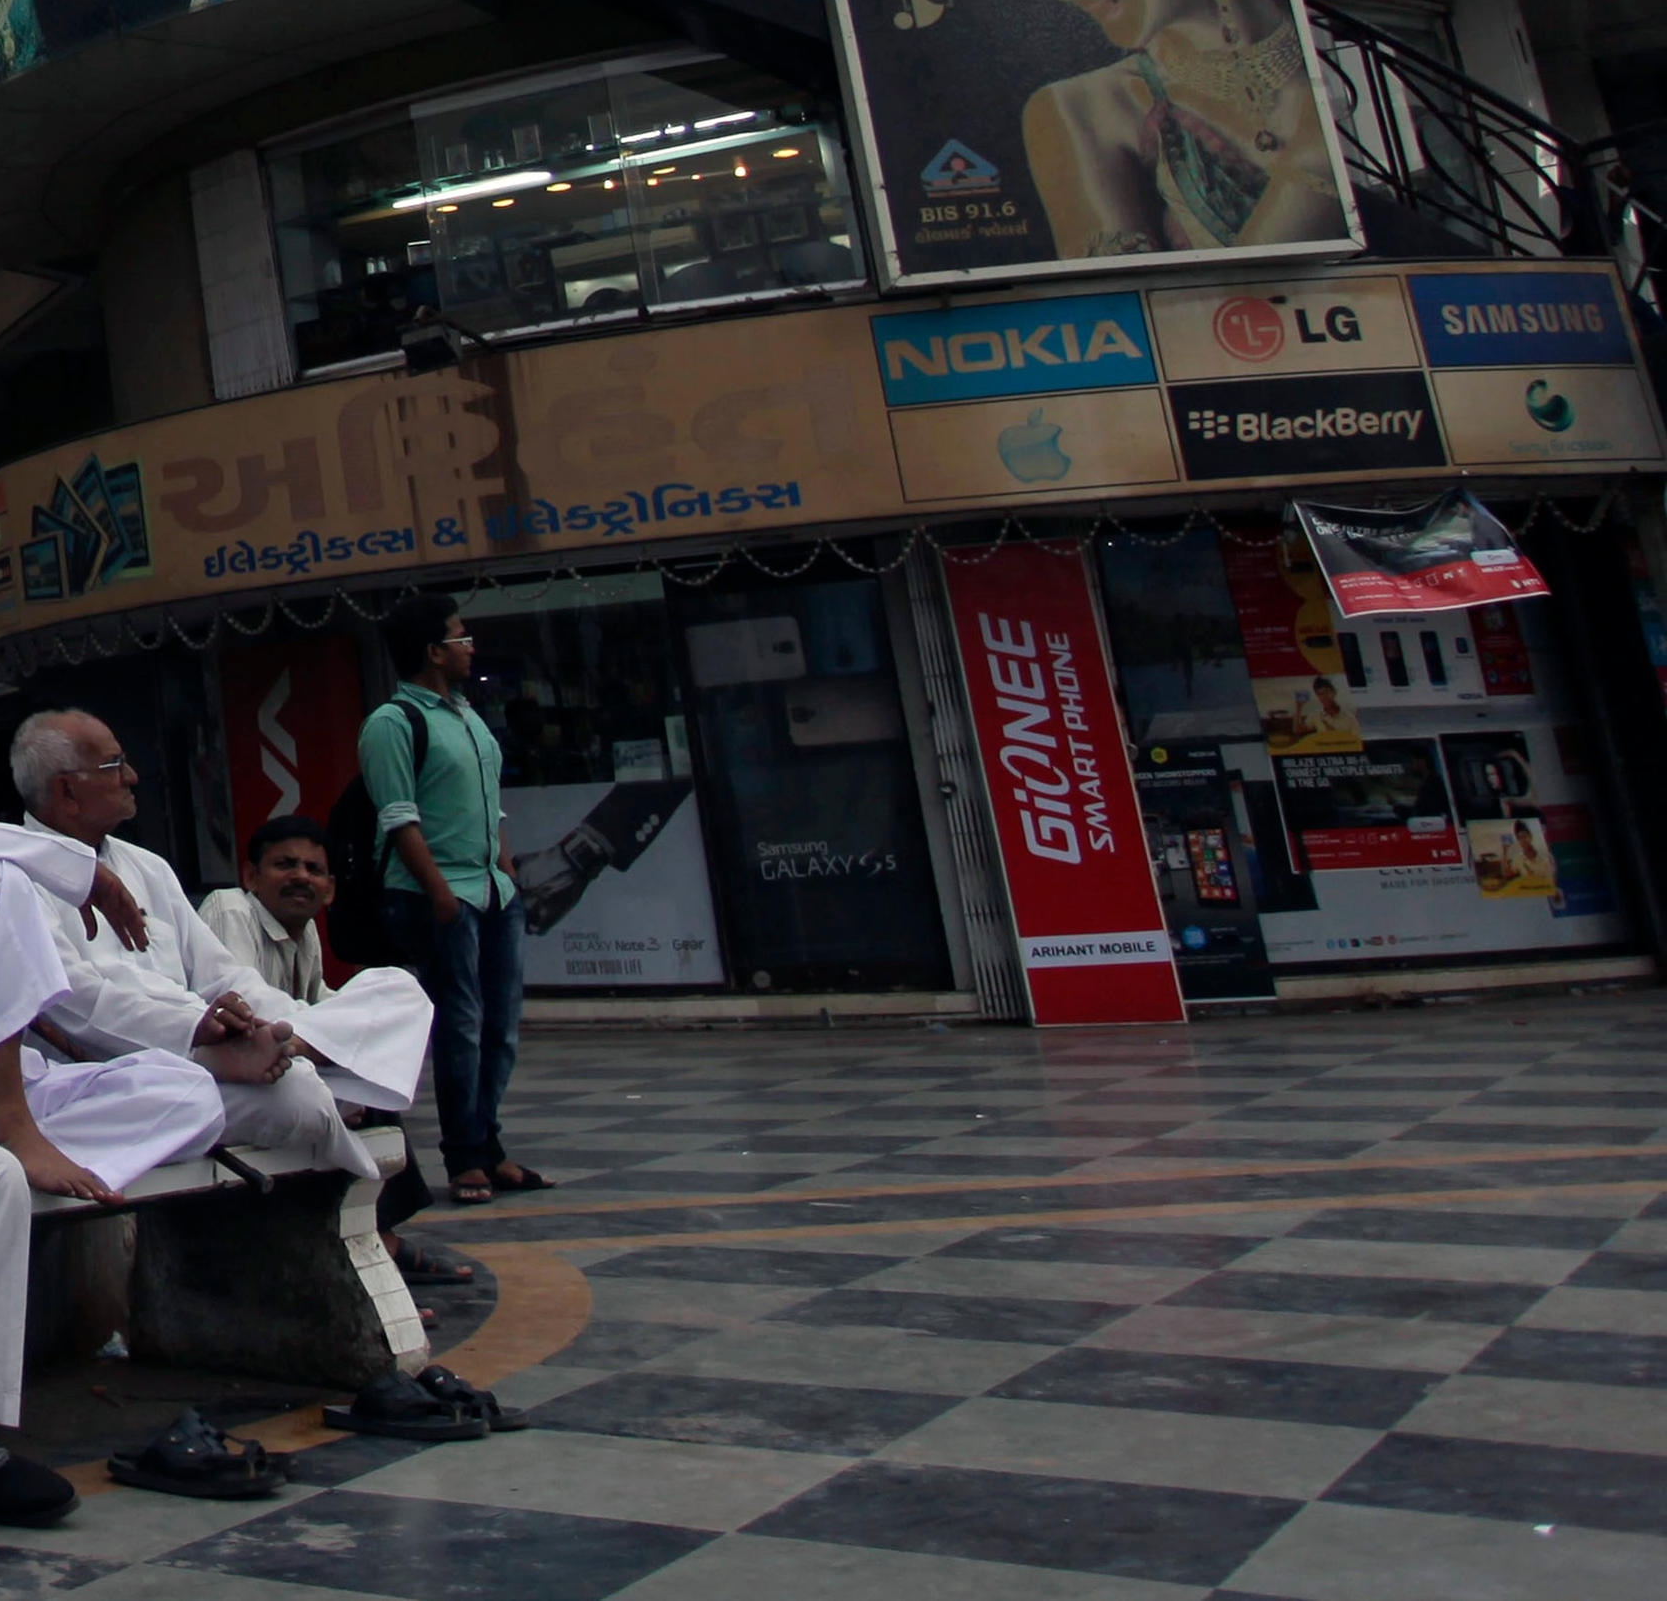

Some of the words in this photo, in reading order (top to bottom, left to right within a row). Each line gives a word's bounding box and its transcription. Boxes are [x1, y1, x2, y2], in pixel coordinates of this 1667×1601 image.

[920, 204, 959, 223] BIS
[965, 200, 1016, 220] 91.6
[1298, 304, 1362, 345] LG
[1442, 303, 1605, 336] SAMSUNG
[884, 319, 1145, 381] NOKIA
[1236, 406, 1424, 443] BlackBerry
[432, 517, 466, 547] &
[757, 839, 828, 857] Samsung
[760, 855, 855, 881] GALAXY
[614, 939, 645, 953] Note
[671, 937, 706, 952] Gear
[1029, 942, 1096, 959] ARIHANT
[1098, 939, 1157, 957] MOBILE
